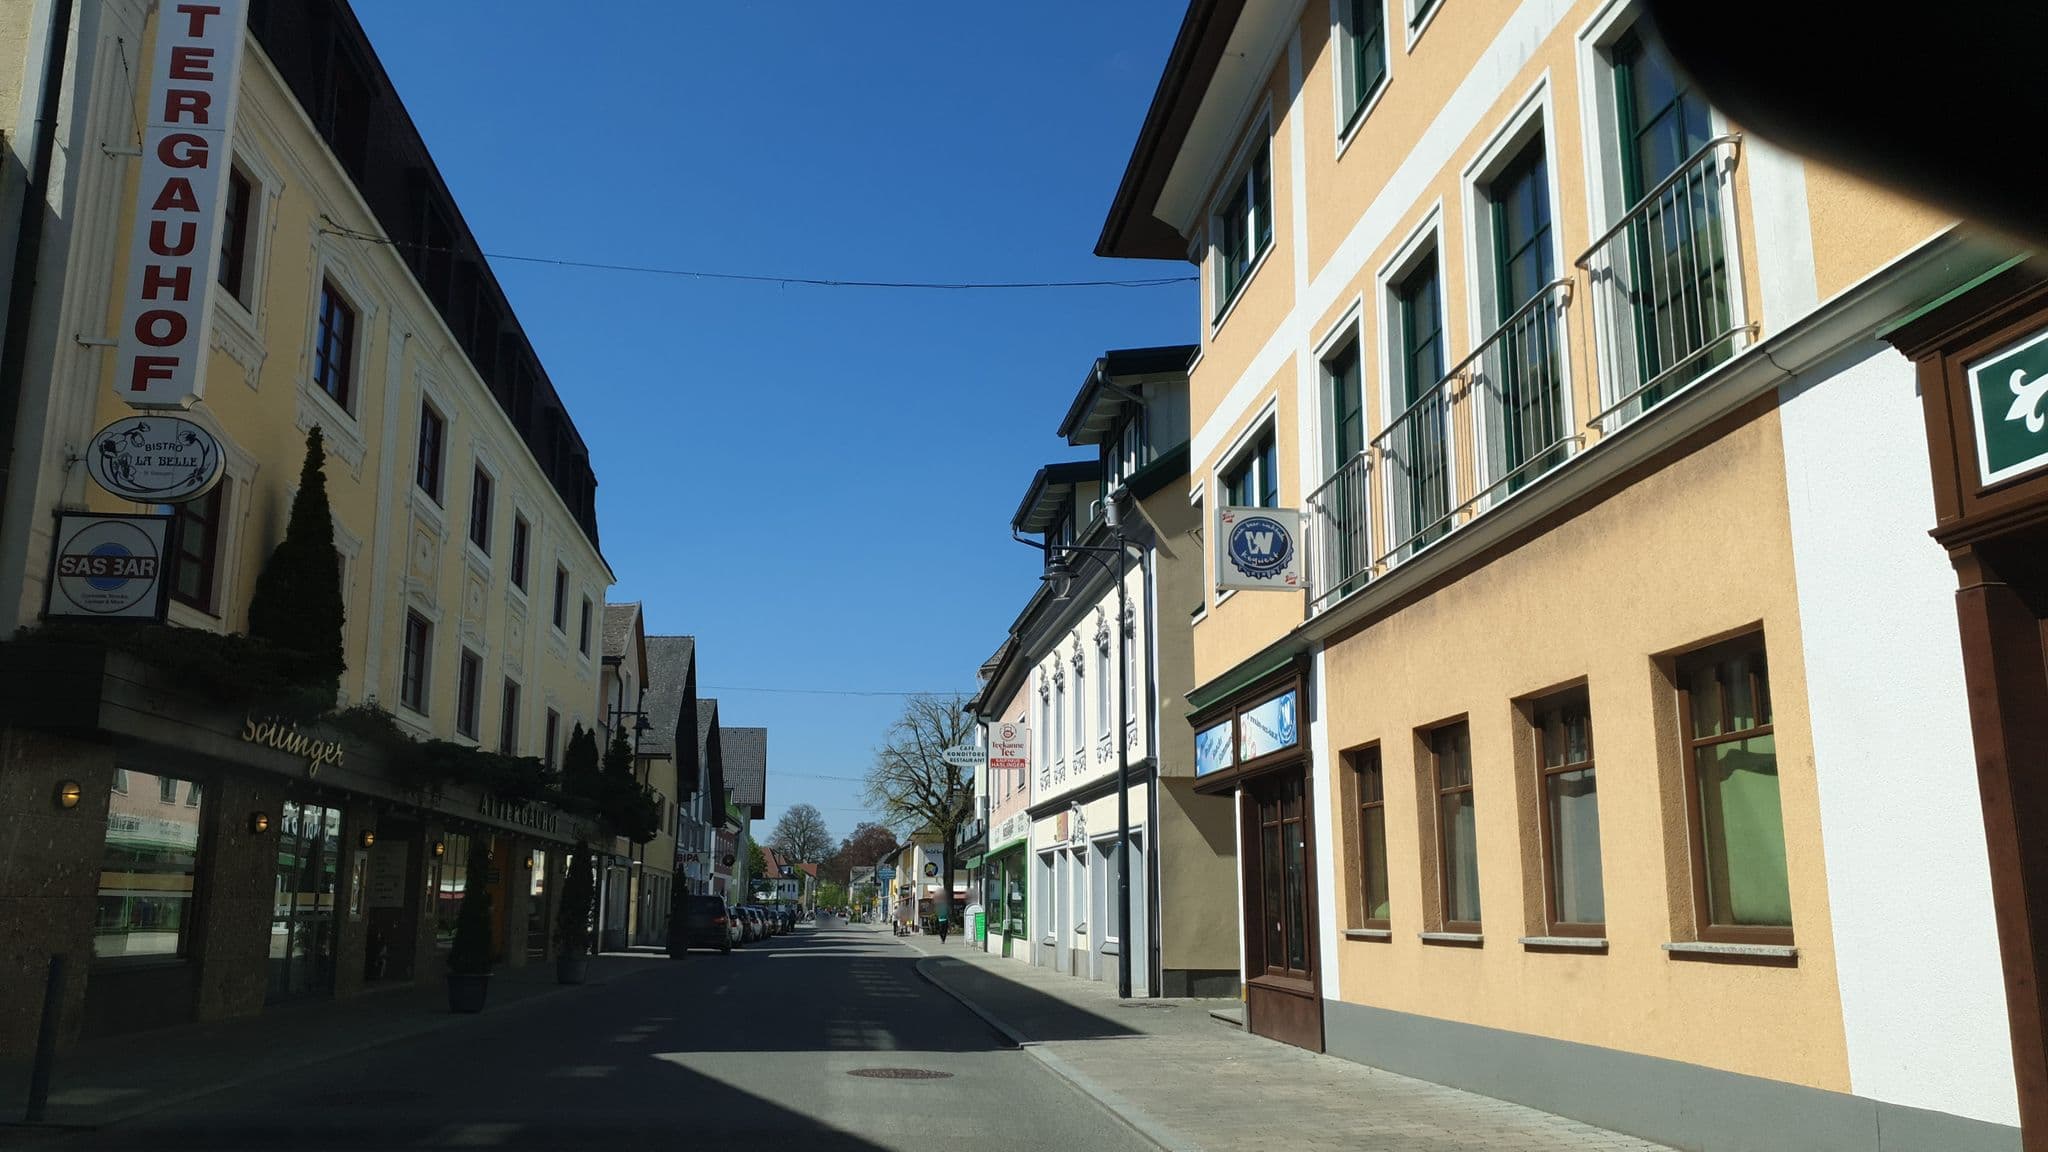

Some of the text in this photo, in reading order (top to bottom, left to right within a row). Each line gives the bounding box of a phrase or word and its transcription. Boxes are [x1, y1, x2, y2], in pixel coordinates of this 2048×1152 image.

[145, 442, 184, 452] BISTRO
[135, 456, 198, 467] LA BELLE
[61, 557, 107, 575] SAS
[992, 741, 1025, 749] Teekanne
[1001, 749, 1016, 757] Tee
